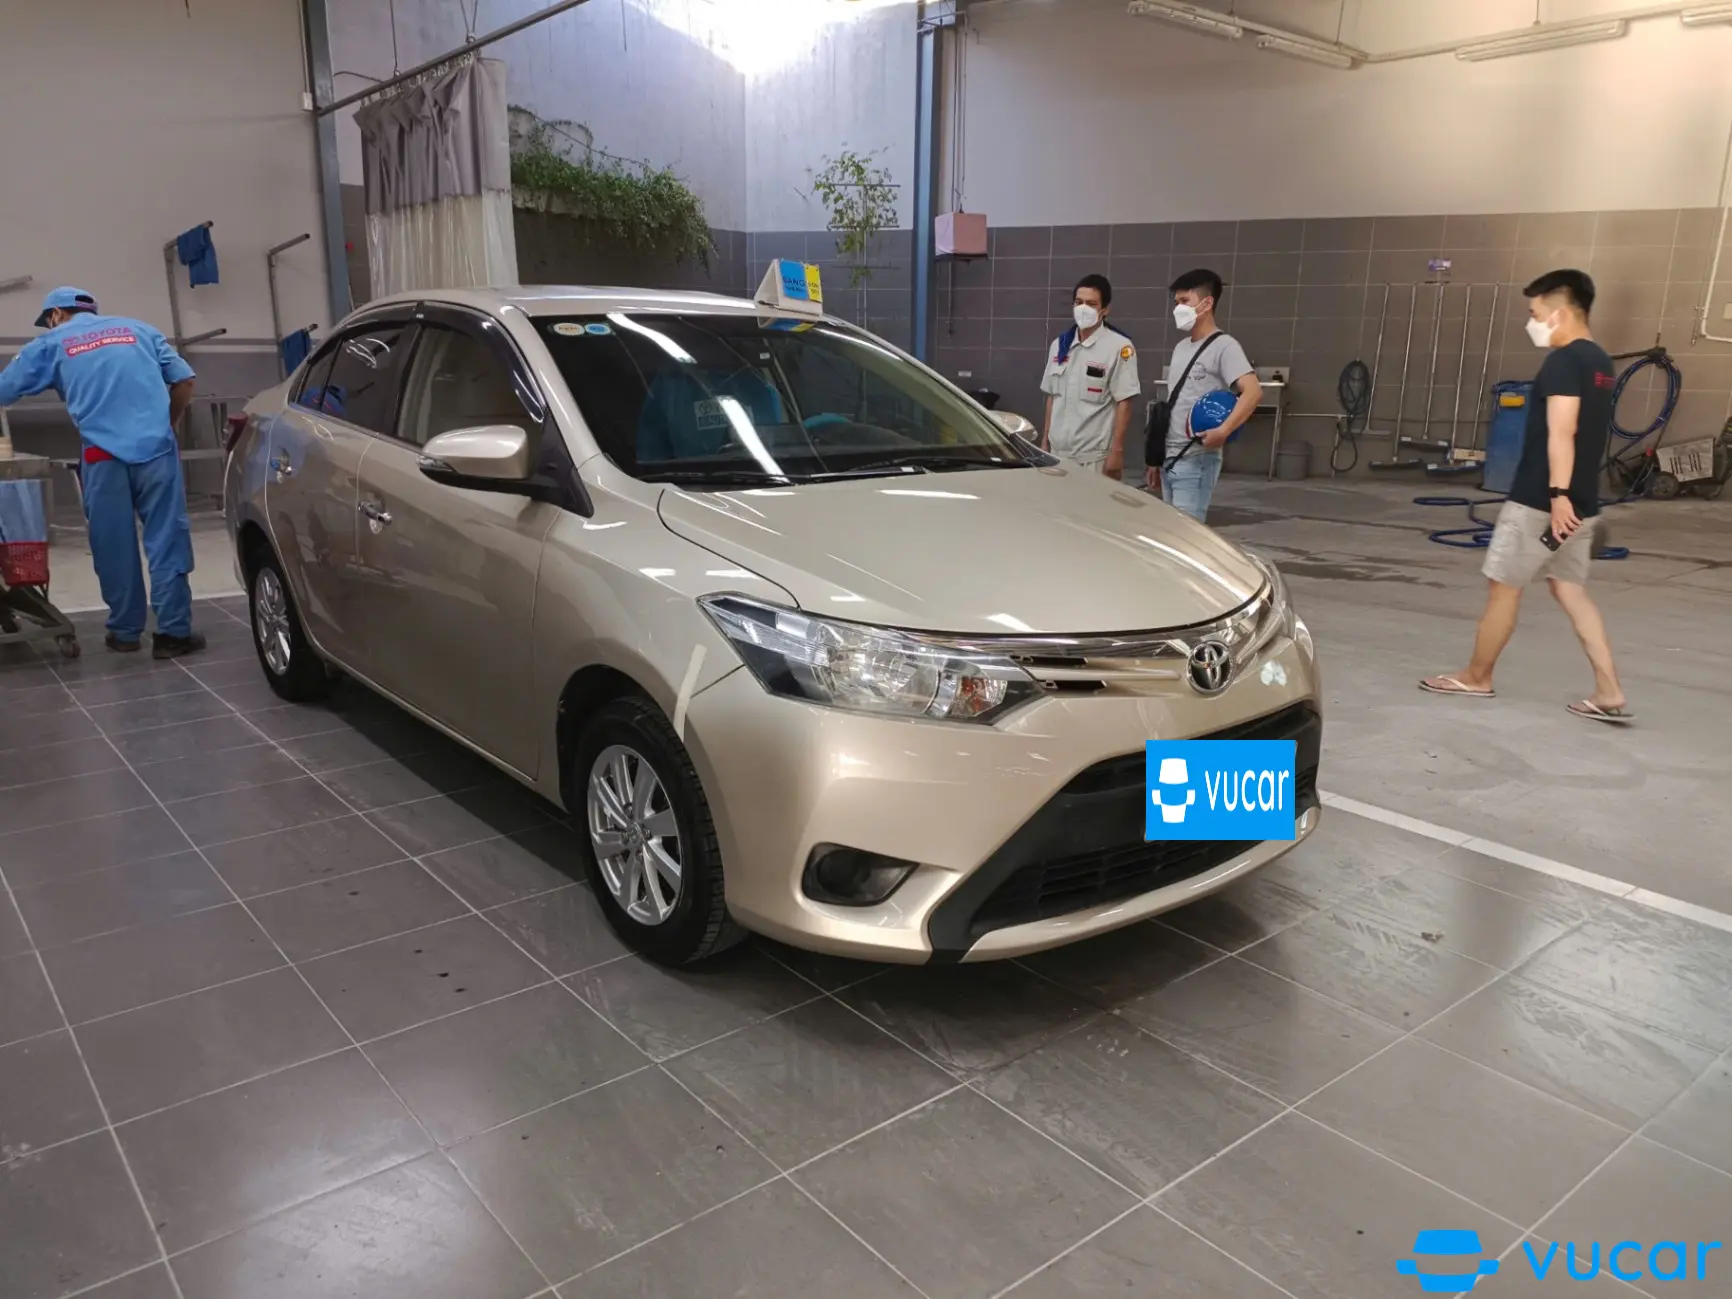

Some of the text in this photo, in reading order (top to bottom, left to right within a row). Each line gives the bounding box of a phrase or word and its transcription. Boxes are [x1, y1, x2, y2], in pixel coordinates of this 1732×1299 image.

[82, 327, 132, 341] TOYOTA
[68, 336, 135, 354] QUALITY SERVICE
